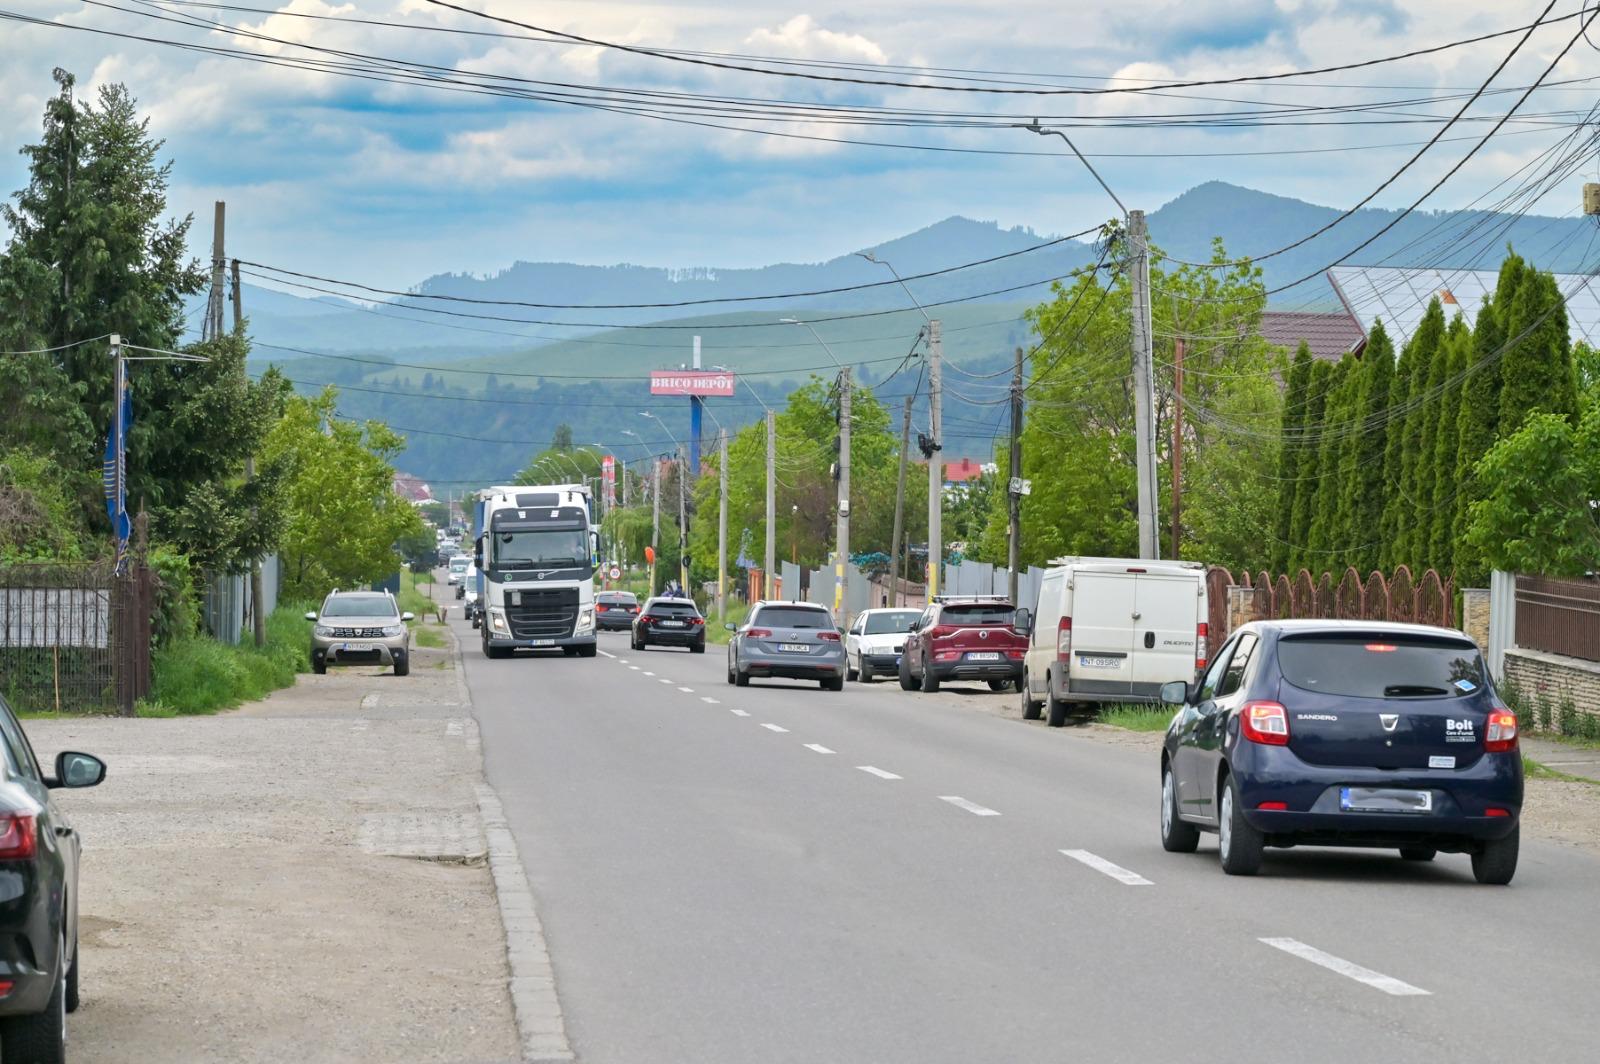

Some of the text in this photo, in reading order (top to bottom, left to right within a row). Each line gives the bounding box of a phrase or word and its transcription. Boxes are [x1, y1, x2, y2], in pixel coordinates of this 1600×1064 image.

[651, 378, 691, 388] BRICO
[1297, 713, 1338, 721] SANDERO
[1446, 719, 1473, 731] Bolt
